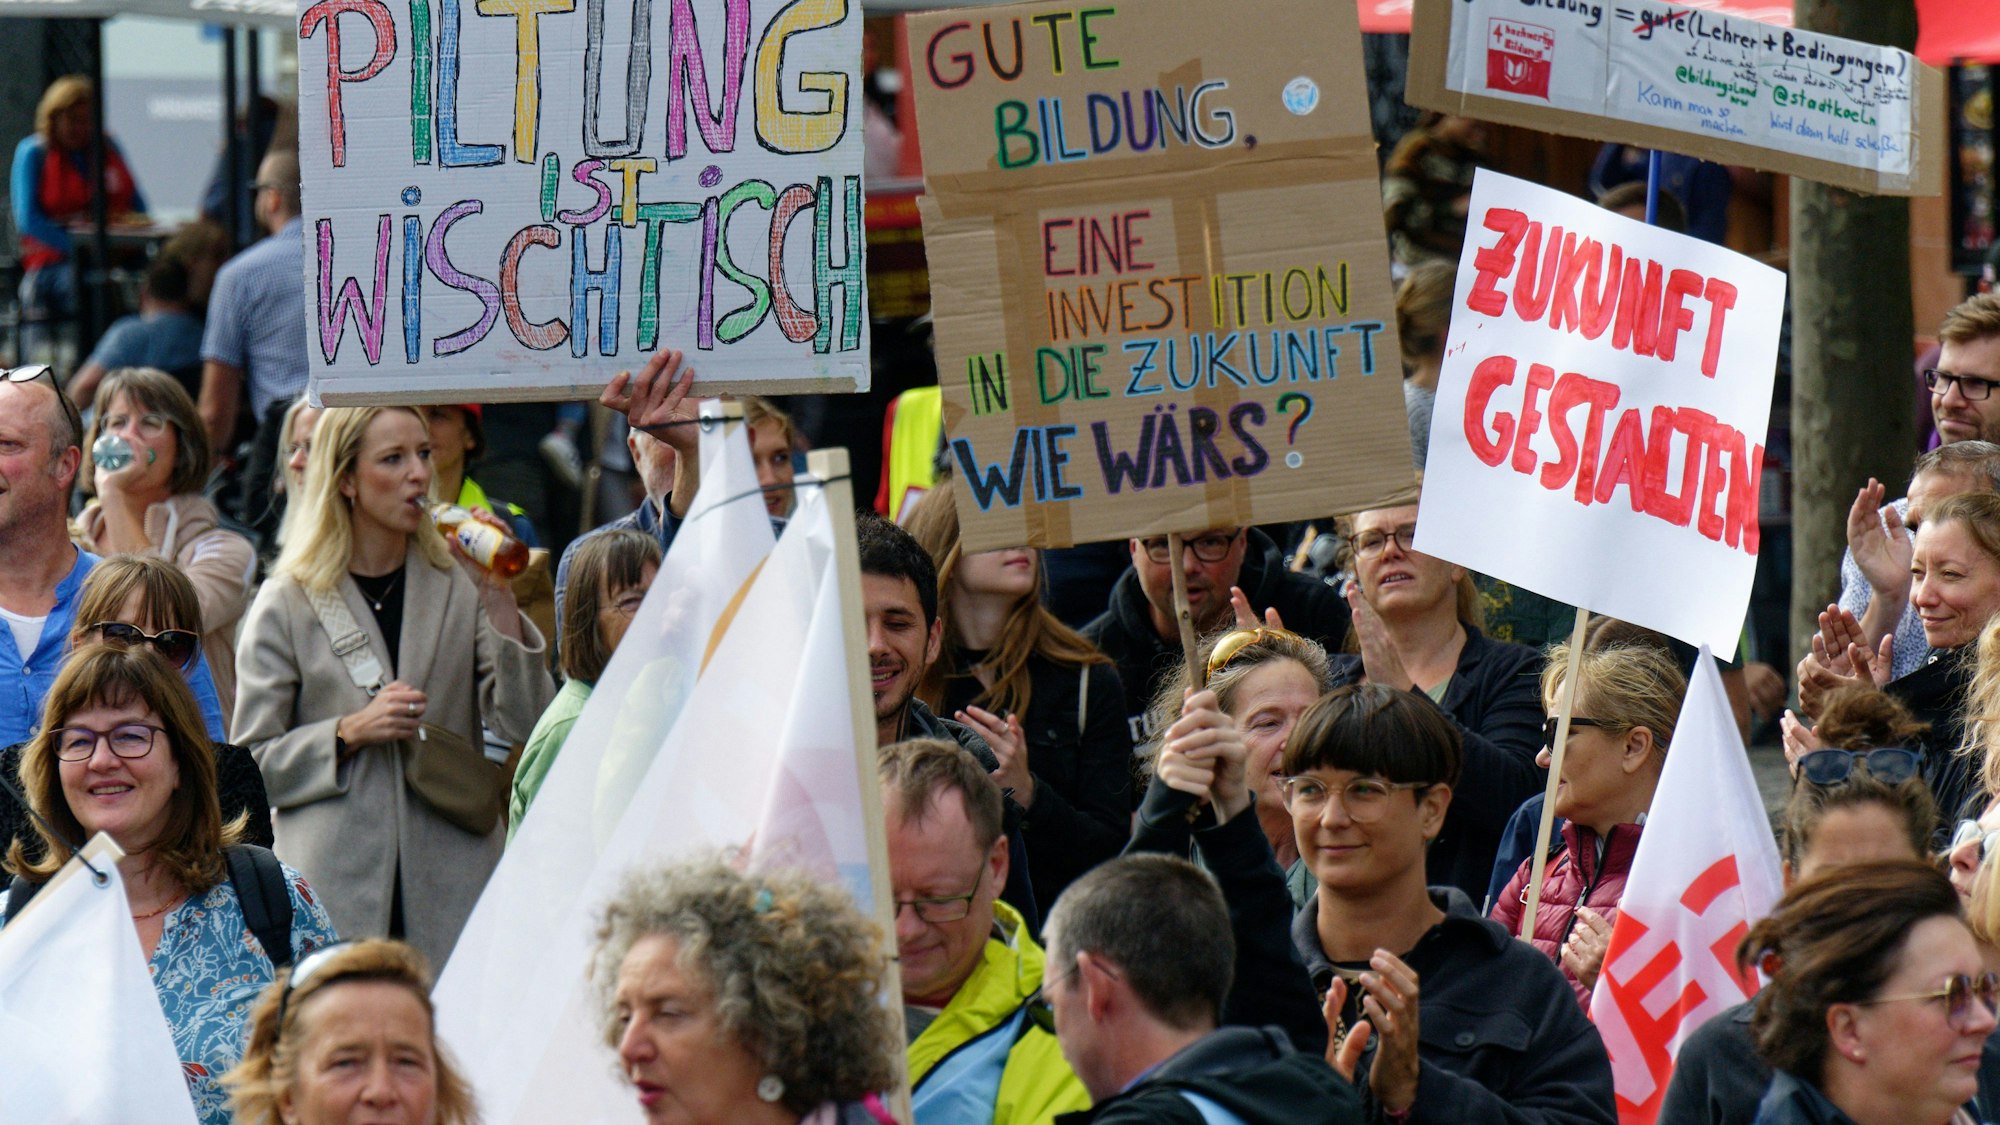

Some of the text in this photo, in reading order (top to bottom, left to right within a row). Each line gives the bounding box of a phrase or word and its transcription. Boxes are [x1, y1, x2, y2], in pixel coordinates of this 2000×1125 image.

[300, 0, 848, 168] PILTUNG
[926, 8, 1120, 90] GUTE
[1637, 80, 1683, 111] Kann
[1773, 85, 1876, 126] @stadtkoeln
[540, 152, 657, 228] IST
[1042, 209, 1155, 277] EINE
[1467, 207, 1739, 379] ZUKUNFT
[966, 321, 1384, 416] IN DIE ZUKUNFT
[950, 424, 1084, 512] WIE
[1463, 355, 1766, 556] GESTALTEN
